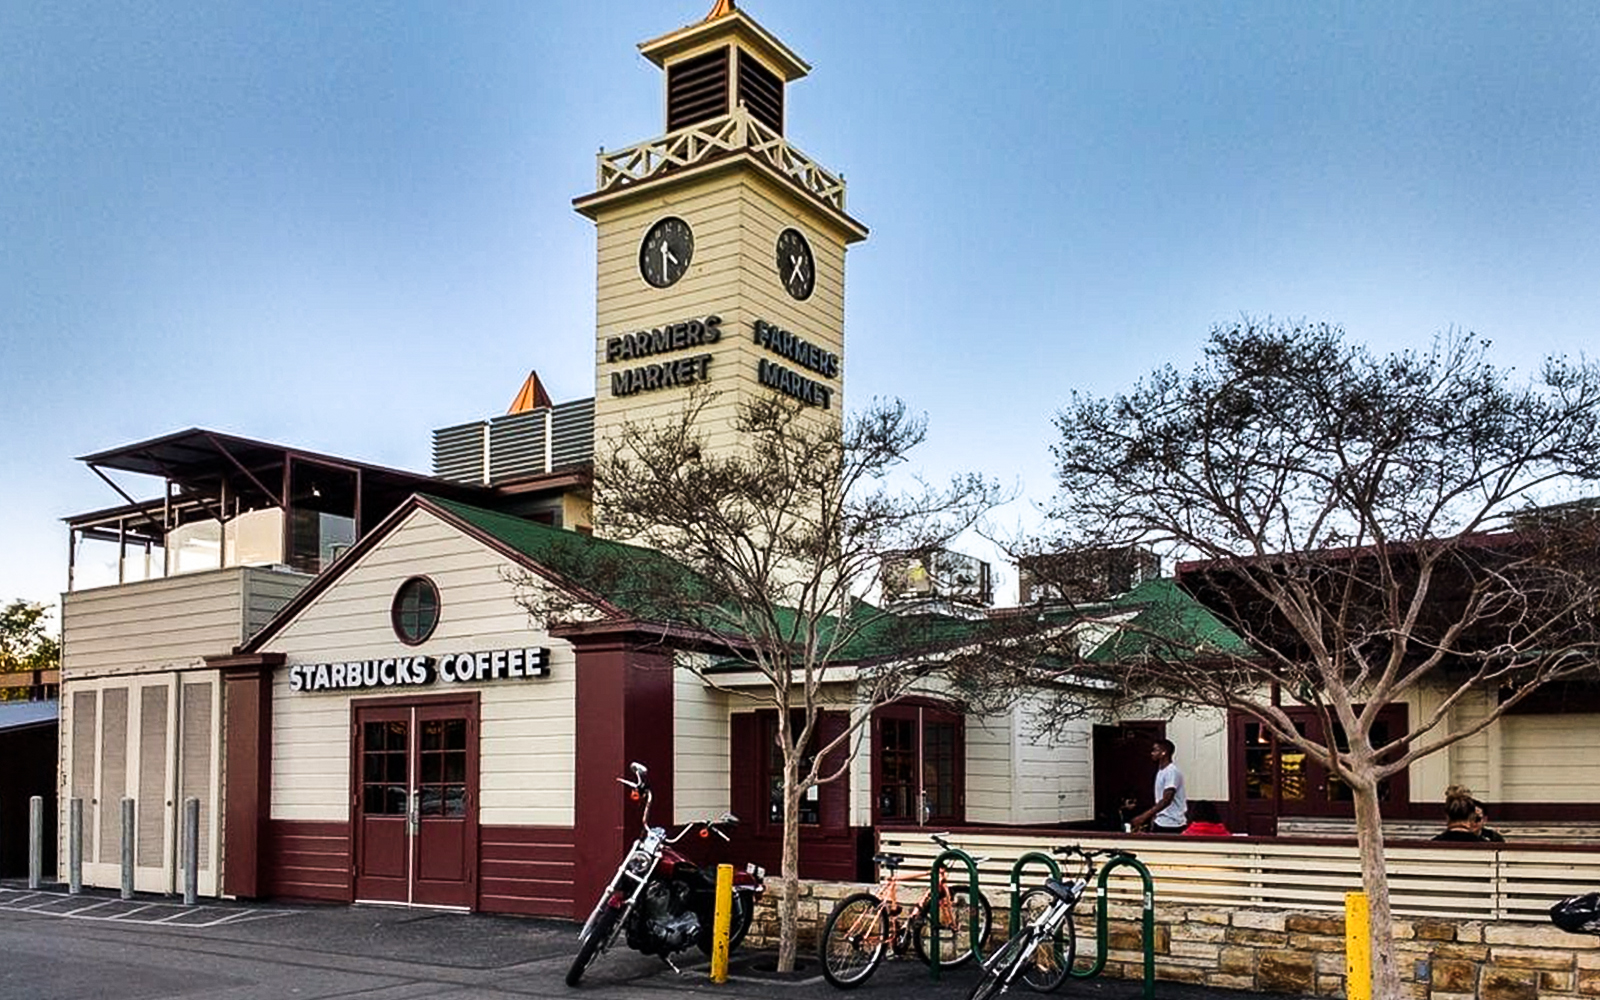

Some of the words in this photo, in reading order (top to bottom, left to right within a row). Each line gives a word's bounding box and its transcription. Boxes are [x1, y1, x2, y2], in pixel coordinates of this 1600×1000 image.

[606, 315, 722, 363] FARMERS
[753, 320, 838, 379] FARMERS
[611, 353, 712, 397] MARKET
[758, 358, 835, 410] MARKET
[289, 655, 430, 692] STARBUCKS
[439, 646, 544, 684] COFFEE
